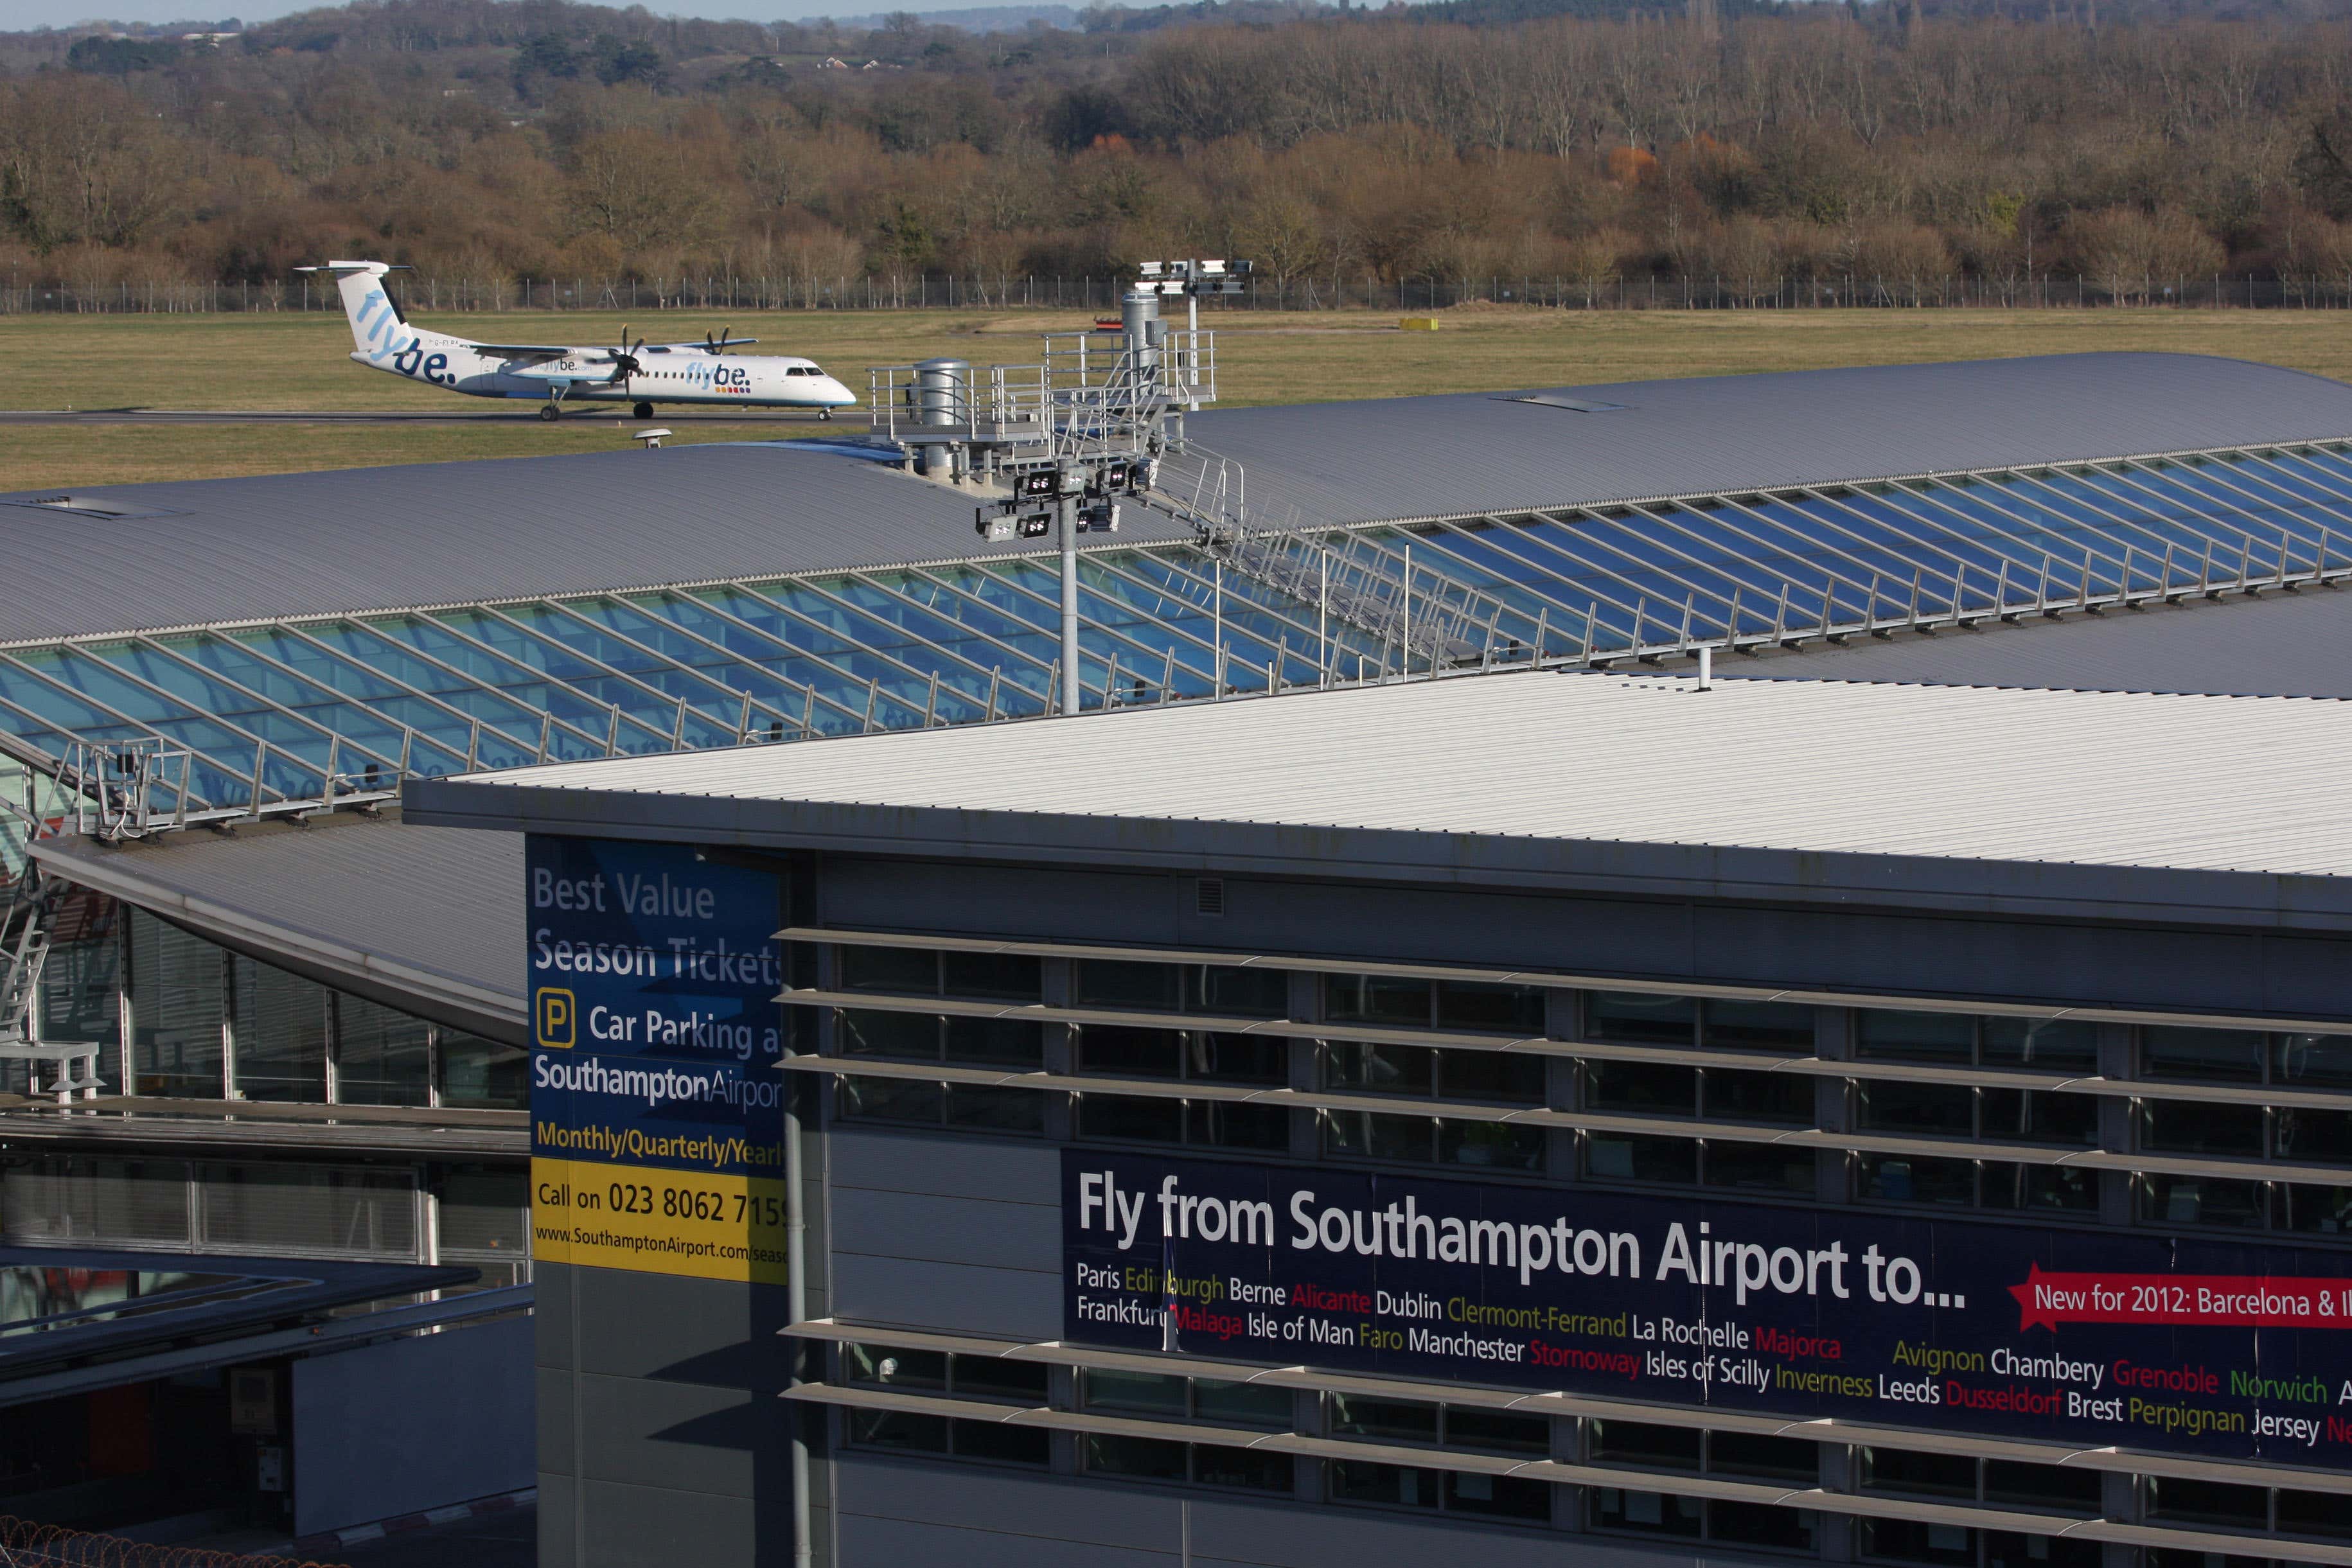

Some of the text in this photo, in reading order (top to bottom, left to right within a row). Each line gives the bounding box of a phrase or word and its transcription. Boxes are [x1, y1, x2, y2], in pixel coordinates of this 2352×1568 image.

[357, 290, 455, 384] flybe.
[685, 362, 750, 390] flybe.
[535, 867, 714, 919] Best Value
[535, 928, 655, 976] Season
[590, 1006, 636, 1041] Car
[647, 1010, 751, 1060] Parking
[763, 1027, 782, 1053] a
[535, 1054, 782, 1114] SouthamptonAirpor
[538, 1121, 784, 1167] Monthly/Quarterly/Yearl
[538, 1183, 570, 1206] Call
[578, 1192, 600, 1209] on
[610, 1183, 653, 1214] 023
[664, 1188, 723, 1221] 8062
[1081, 1171, 1965, 1308] Fly from Southampton Airport to...
[2035, 1284, 2085, 1310] New
[2092, 1283, 2126, 1311] for
[2132, 1286, 2190, 1313] 2012:
[2198, 1288, 2310, 1316] Barcelona
[2318, 1290, 2334, 1316] &
[1077, 1262, 1120, 1289] Paris
[1230, 1278, 1286, 1305] Berne
[1291, 1283, 1370, 1314] Alicante
[1377, 1291, 1441, 1319] Dublin
[1448, 1297, 1626, 1337] Clermont-Ferrand
[1633, 1315, 1654, 1340] La
[1663, 1317, 1749, 1349] Rochelle
[1755, 1326, 1840, 1361] Majorca
[1893, 1340, 1984, 1375] Avignon
[1991, 1348, 2104, 1389] Chambery
[2113, 1360, 2219, 1394] Grenoble
[2231, 1370, 2327, 1403] Norwich
[1077, 1295, 1165, 1327] Frankfurt
[1169, 1304, 1242, 1339] Malaga
[1248, 1313, 1277, 1339] Isle
[1284, 1314, 1304, 1340] of
[1310, 1319, 1353, 1345] Man
[1361, 1323, 1402, 1350] Faro
[1409, 1327, 1525, 1362] Manchester
[1531, 1339, 1641, 1380] Stornoway
[1647, 1351, 1686, 1377] Isles
[1692, 1356, 1713, 1380] of
[1720, 1358, 1770, 1393] Scilly
[1776, 1364, 1873, 1397] Inverness
[1879, 1375, 1939, 1404] Leeds
[1947, 1381, 2062, 1414] Dusseldorf
[2068, 1391, 2123, 1421] Brest
[2130, 1398, 2245, 1436] Perpignan
[2252, 1409, 2320, 1446] Jersey
